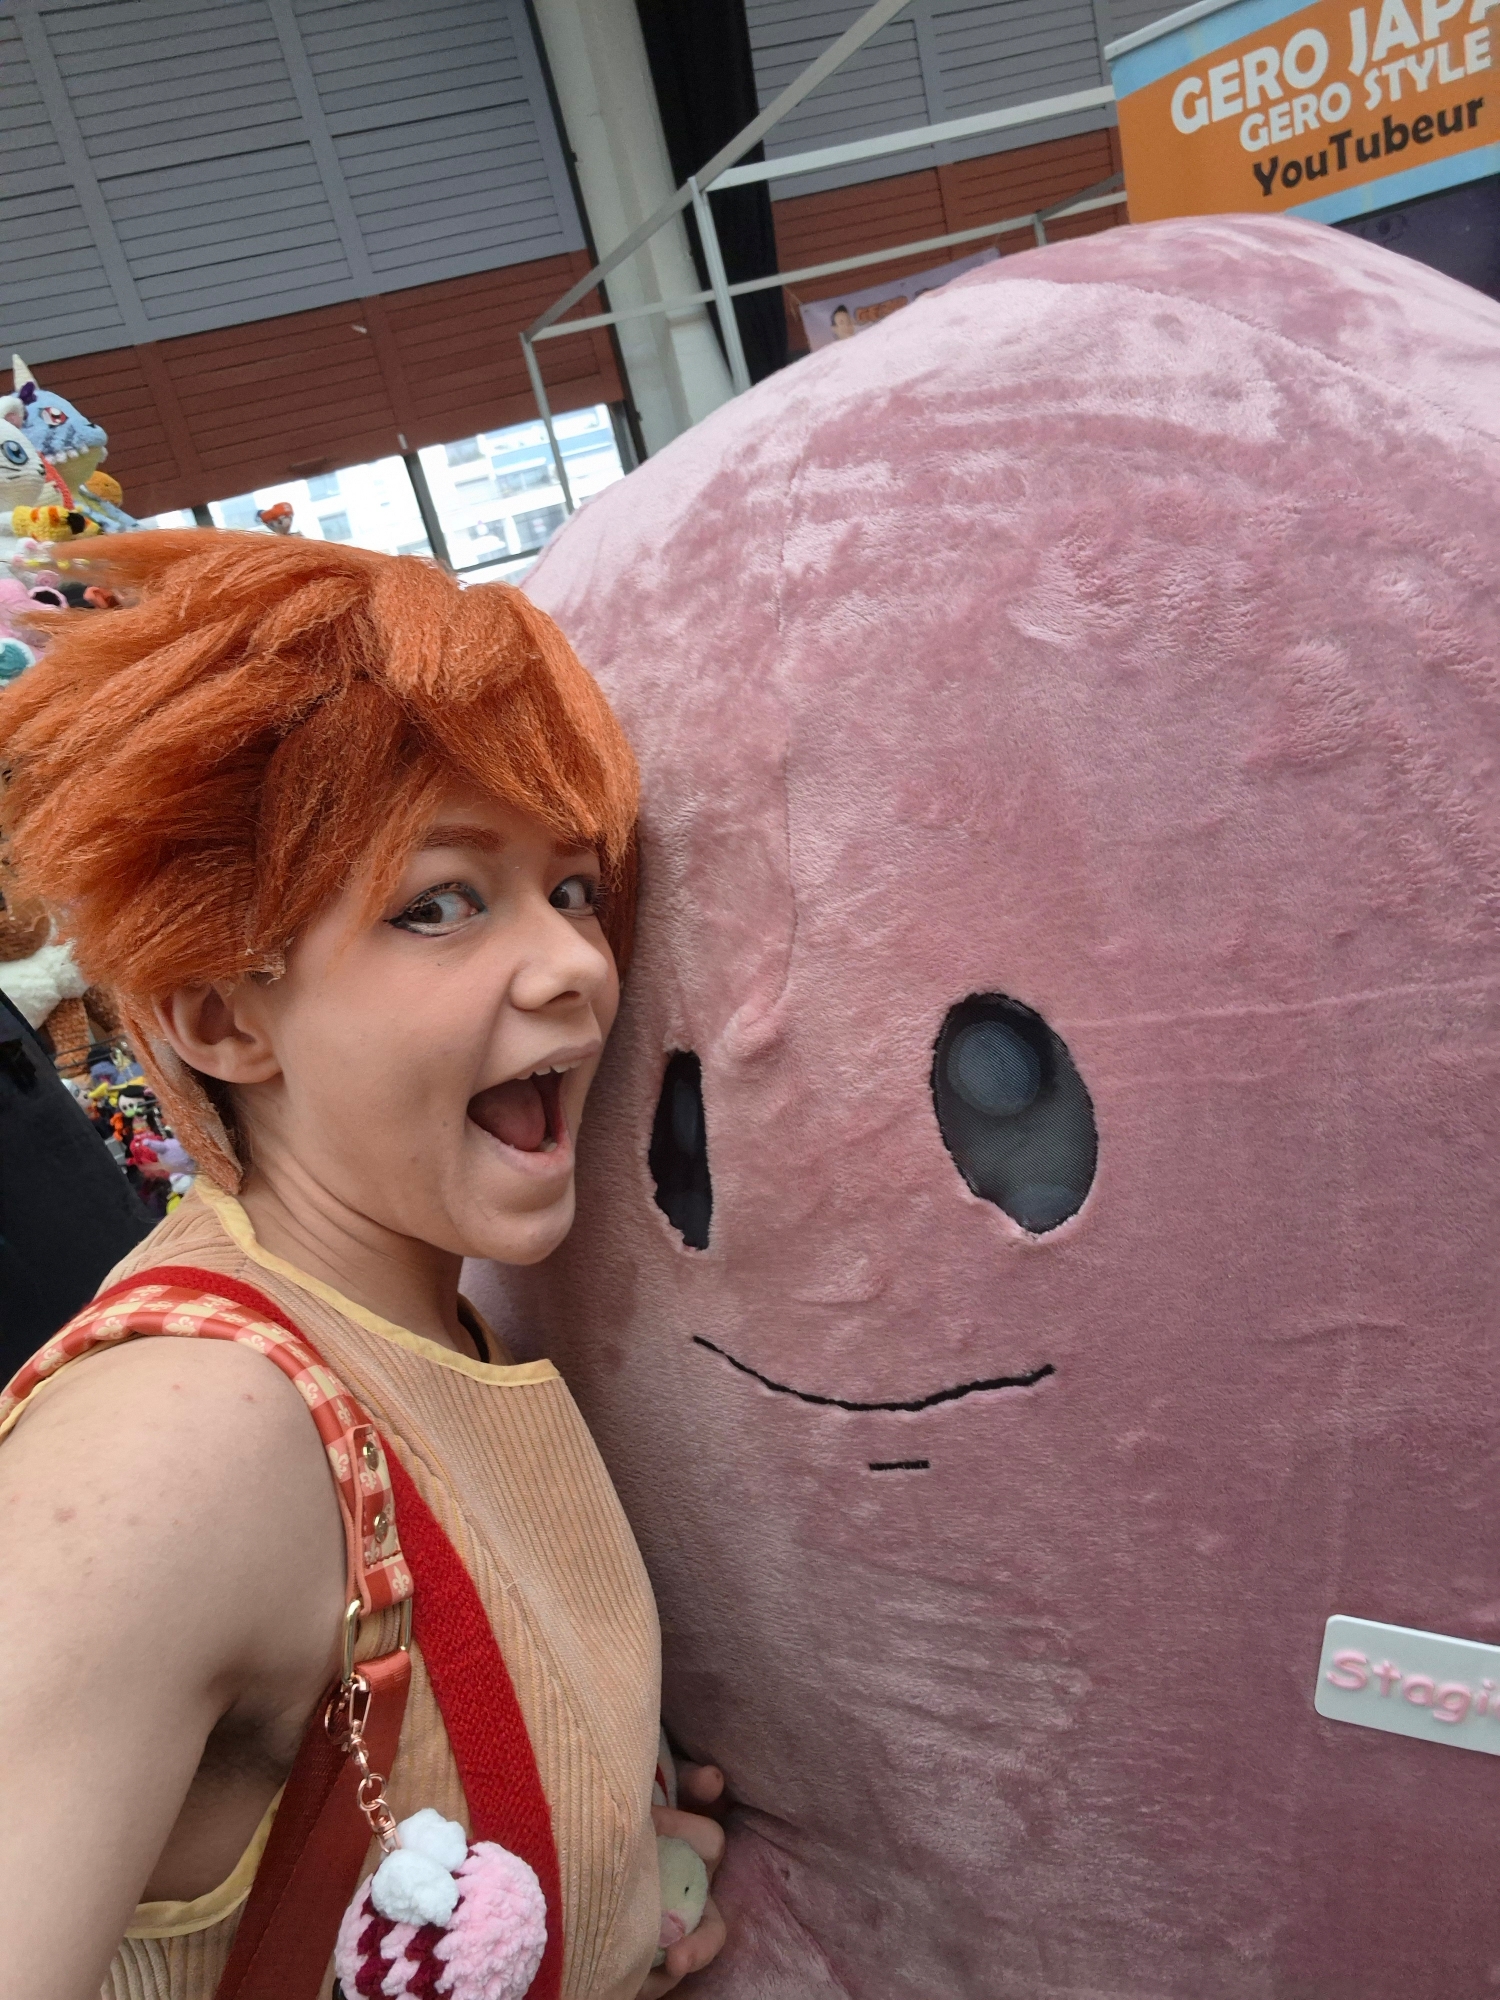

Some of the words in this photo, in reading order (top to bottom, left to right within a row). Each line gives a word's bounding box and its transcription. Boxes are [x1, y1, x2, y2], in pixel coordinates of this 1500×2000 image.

[1170, 28, 1329, 134] GERO
[1239, 82, 1352, 152] GERO
[1363, 26, 1491, 111] STYLE
[1252, 97, 1484, 197] YouTubeur
[1326, 1650, 1500, 1723] Stagi
